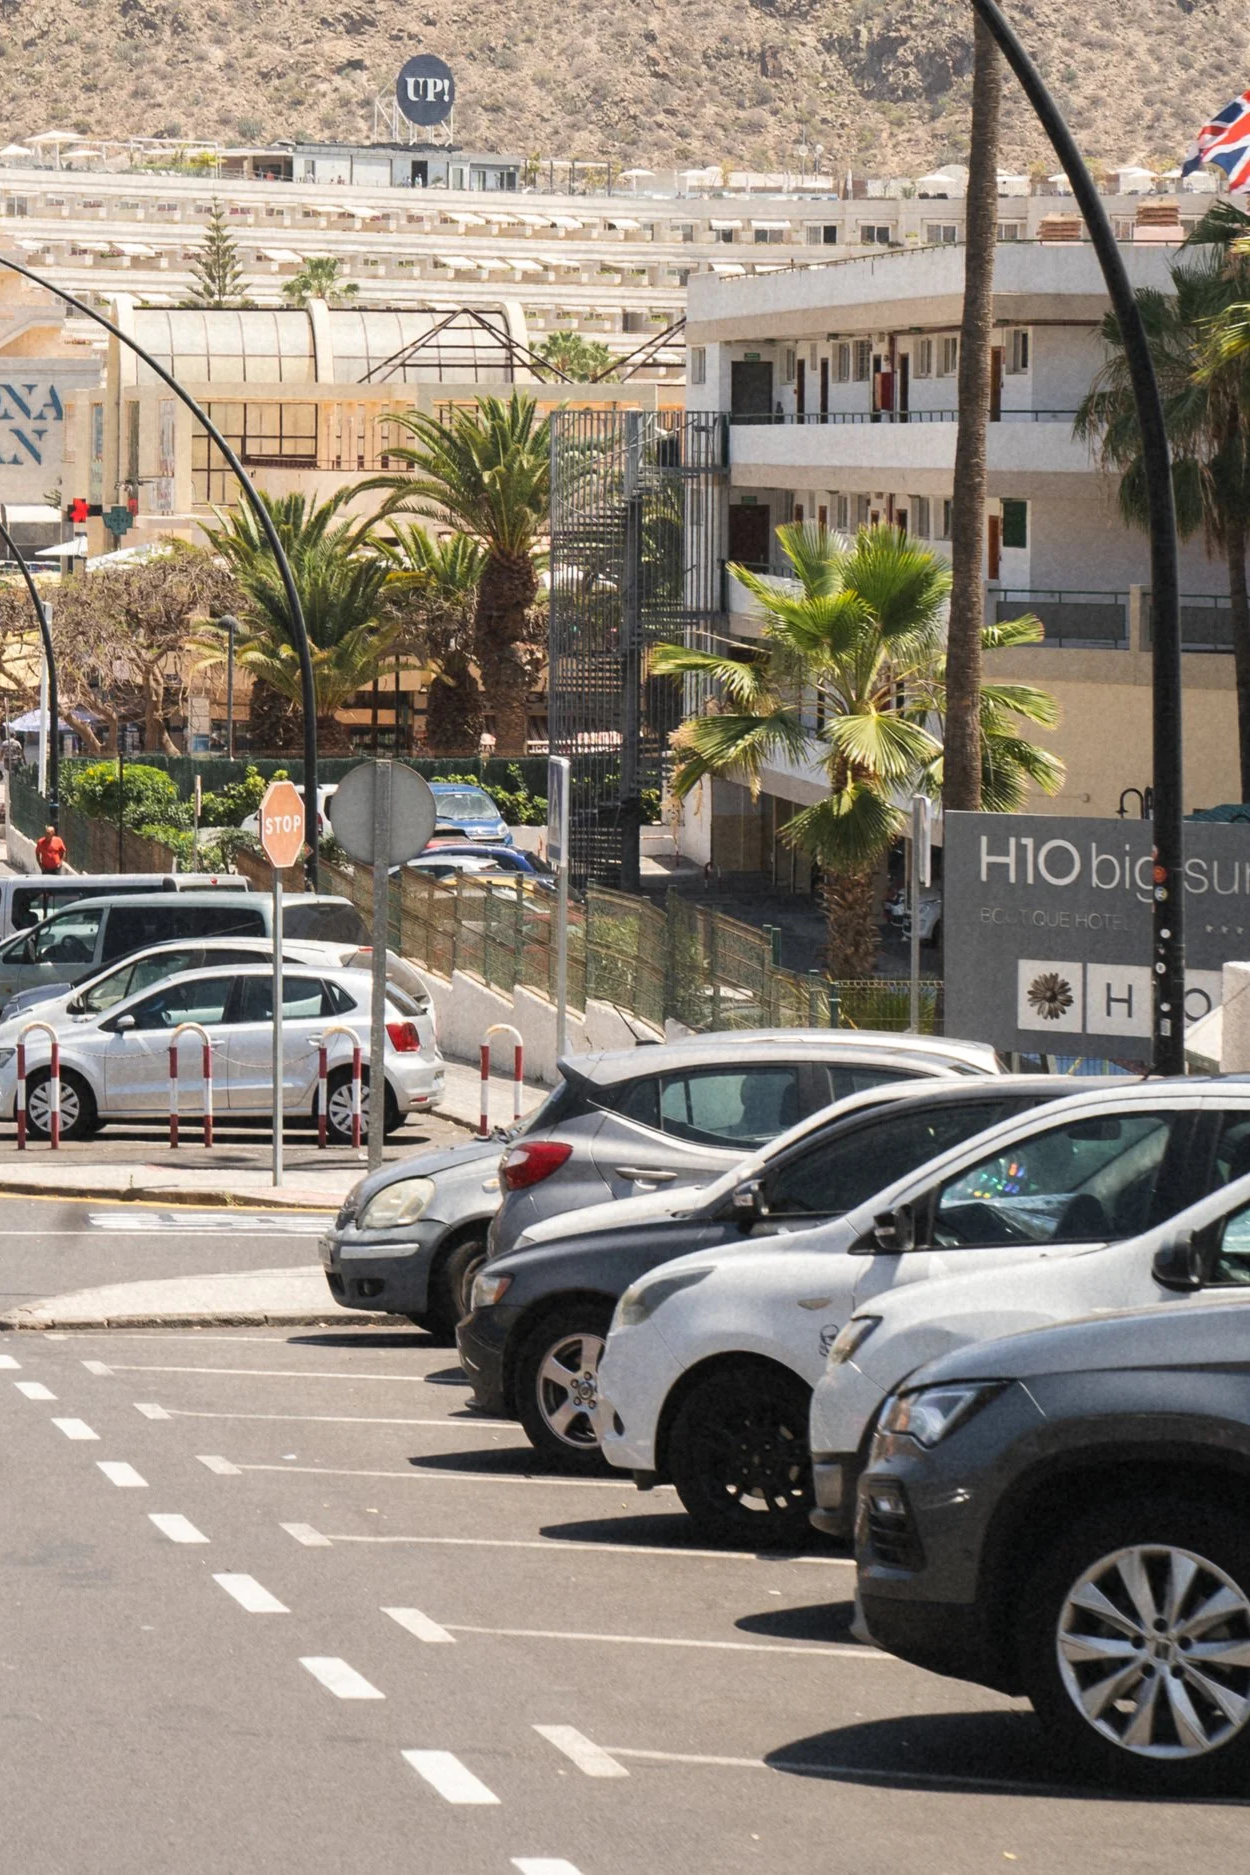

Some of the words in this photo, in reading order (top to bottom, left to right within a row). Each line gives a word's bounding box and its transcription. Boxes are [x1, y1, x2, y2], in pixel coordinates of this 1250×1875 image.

[405, 77, 450, 102] UP!
[265, 815, 301, 835] STOP
[980, 835, 1081, 887] H10
